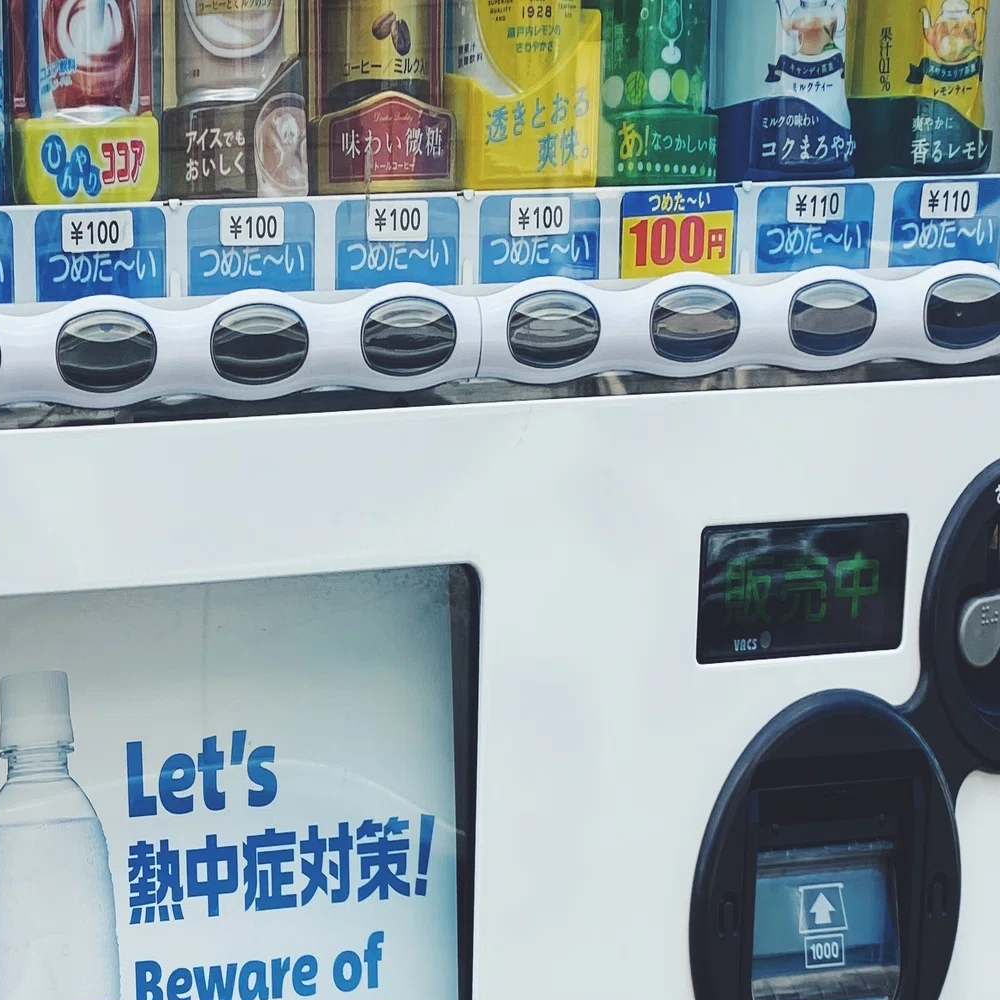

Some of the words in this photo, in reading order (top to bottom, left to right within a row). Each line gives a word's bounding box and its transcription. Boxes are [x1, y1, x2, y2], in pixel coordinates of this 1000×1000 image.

[522, 5, 552, 18] 1928
[792, 81, 833, 93] ミルクティー
[933, 86, 973, 97] レモンティー
[485, 85, 590, 146] 透きとおる
[762, 113, 820, 129] ミルクの味わい
[911, 115, 954, 132] 爽やかに
[185, 127, 246, 154] アイスでも
[341, 127, 444, 159] 味わい微糖
[761, 134, 857, 163] コクまろやか
[185, 151, 246, 182] おいしく
[795, 192, 839, 217] ¥110
[928, 189, 971, 213] ¥110
[229, 214, 278, 240] ¥100
[374, 206, 421, 232] ¥100
[518, 205, 563, 230] ¥100
[70, 220, 120, 246] ¥100
[629, 215, 727, 267] 100円
[733, 638, 758, 652] VACS
[126, 729, 278, 818] Let's
[128, 813, 435, 925] 熱中症対策!
[332, 930, 385, 993] of
[809, 941, 840, 961] 1000
